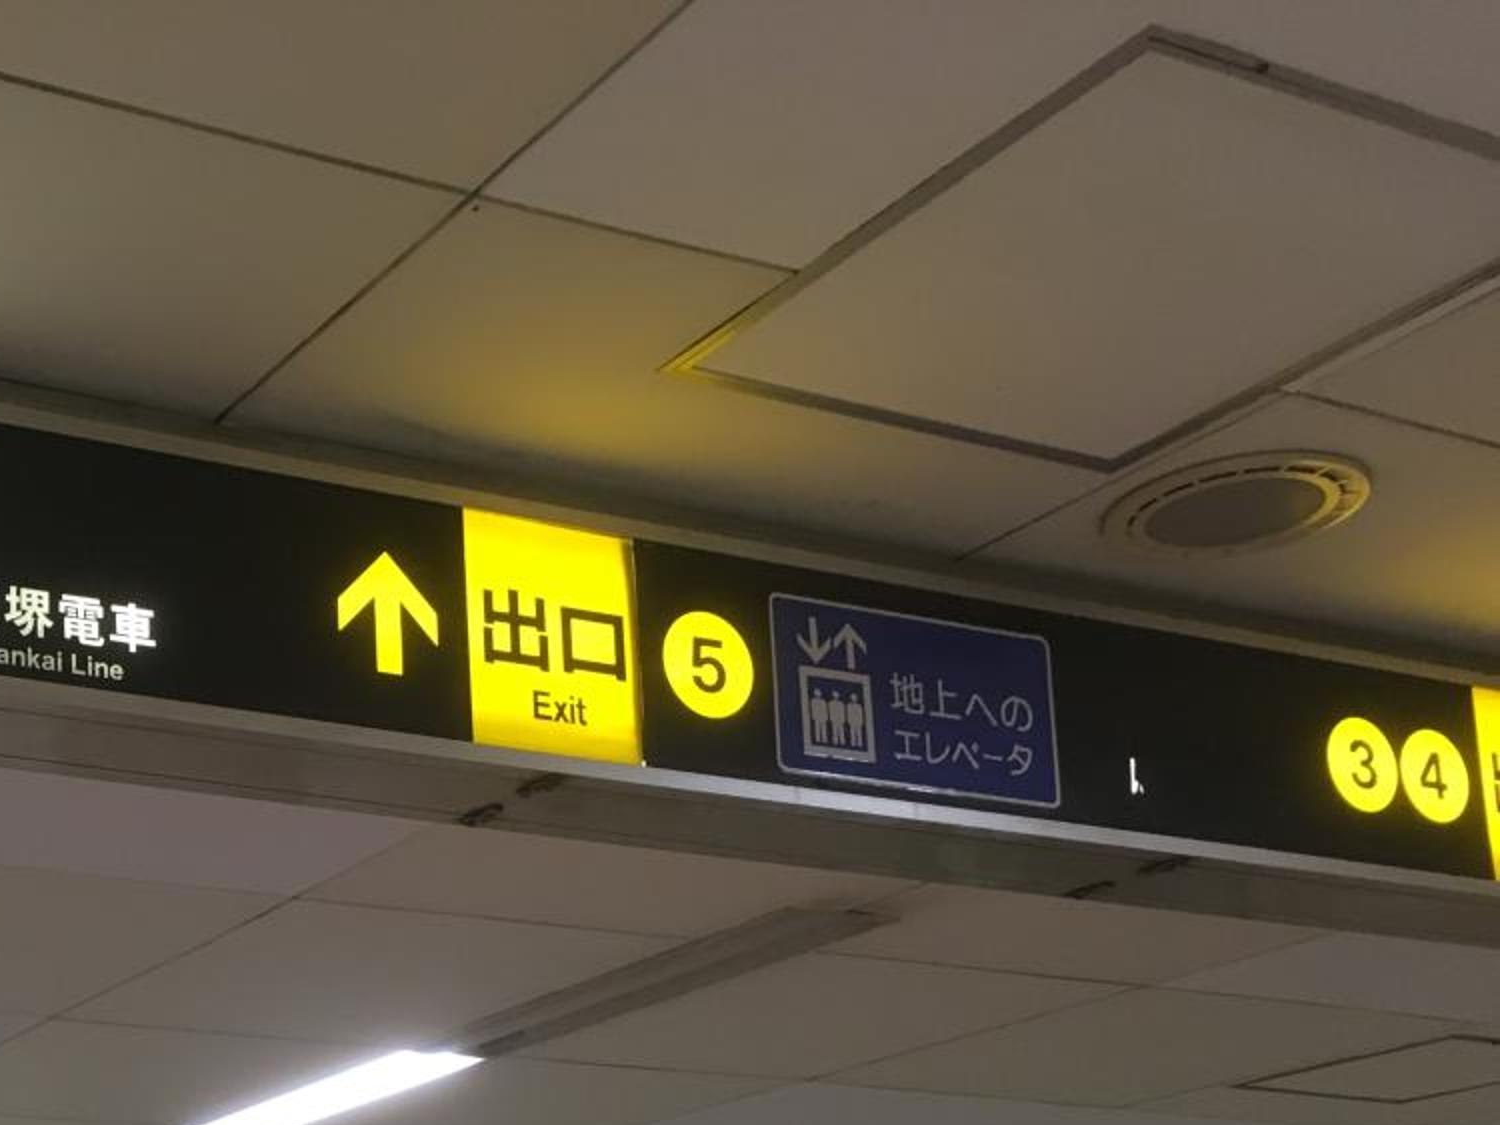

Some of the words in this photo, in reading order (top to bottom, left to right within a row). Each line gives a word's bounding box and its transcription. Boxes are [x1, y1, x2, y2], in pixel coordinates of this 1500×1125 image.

[483, 588, 628, 682] 出口
[71, 653, 124, 681] Line
[691, 637, 724, 694] 5
[531, 690, 589, 727] Exit
[889, 671, 1034, 733] 地上への
[893, 729, 1033, 776] エレベータ
[1349, 739, 1378, 790] 3
[1420, 752, 1448, 800] 4
